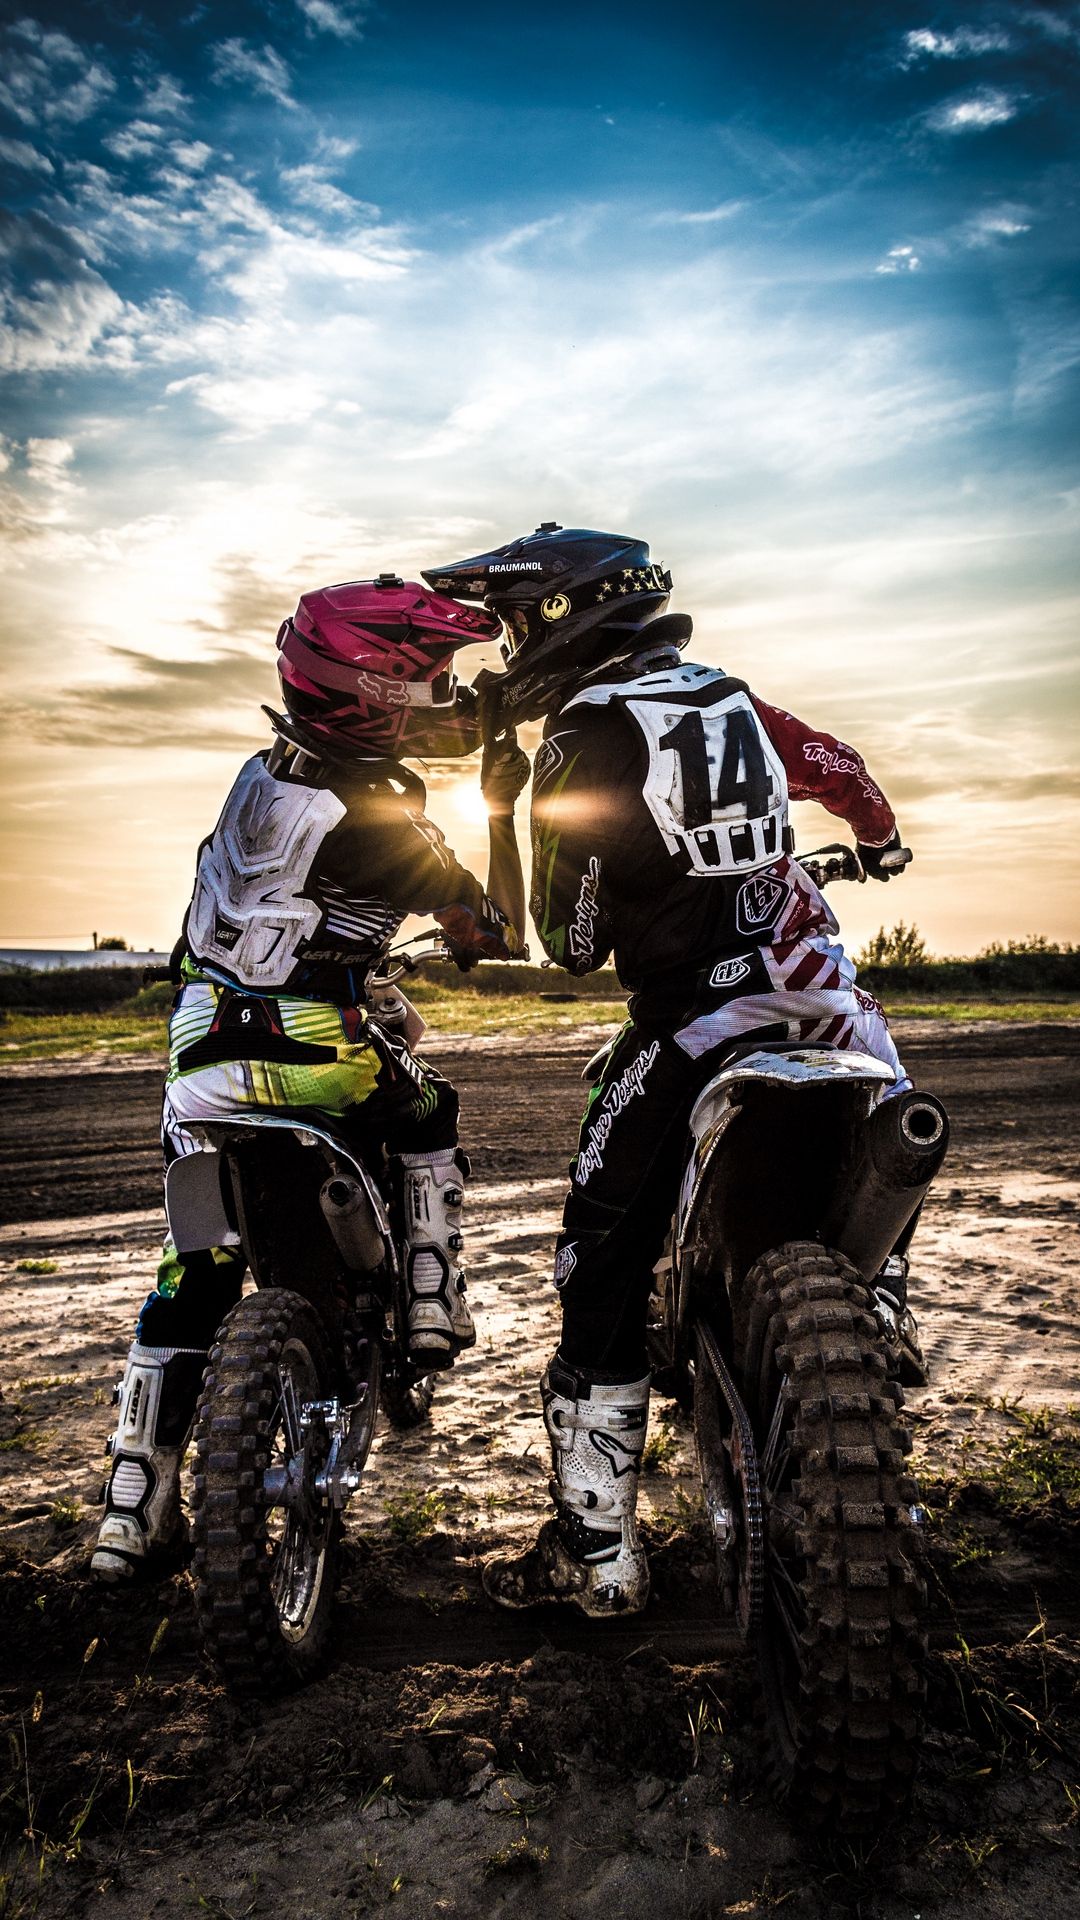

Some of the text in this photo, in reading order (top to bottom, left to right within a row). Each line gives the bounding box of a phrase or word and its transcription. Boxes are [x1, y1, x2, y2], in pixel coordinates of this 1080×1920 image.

[488, 561, 543, 574] BRAUMANDL
[659, 710, 773, 831] 14
[602, 1040, 661, 1117] Designs
